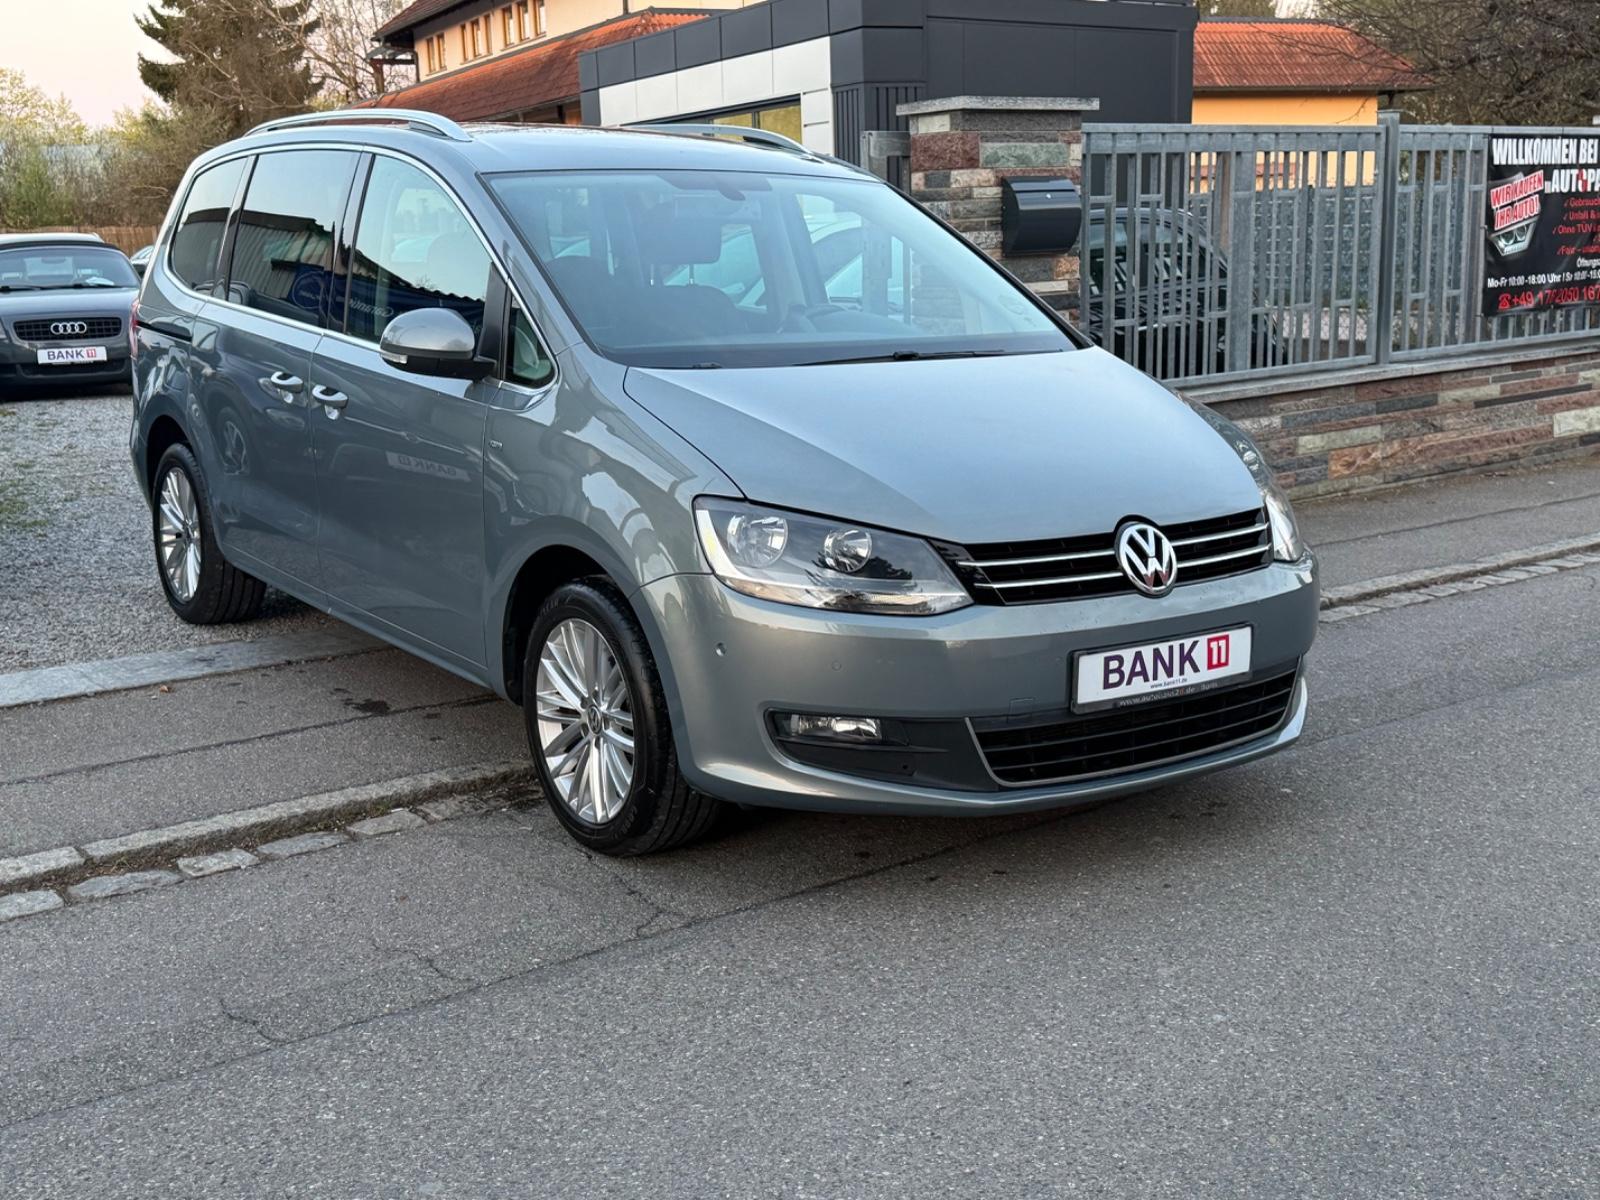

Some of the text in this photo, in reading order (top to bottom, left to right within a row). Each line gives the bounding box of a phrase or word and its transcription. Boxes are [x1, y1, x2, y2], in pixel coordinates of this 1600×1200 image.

[1492, 138, 1599, 165] WILLKOMMEN BEI
[1491, 184, 1511, 207] WIR
[1512, 171, 1543, 199] KAUFEN
[1495, 196, 1539, 229] IHR AUTO!
[1487, 277, 1507, 288] Mo-Fr
[1547, 272, 1561, 283] Uhr
[47, 349, 85, 360] BANK
[1102, 638, 1228, 690] BANK 11
[1150, 677, 1188, 689] www.bank11.de
